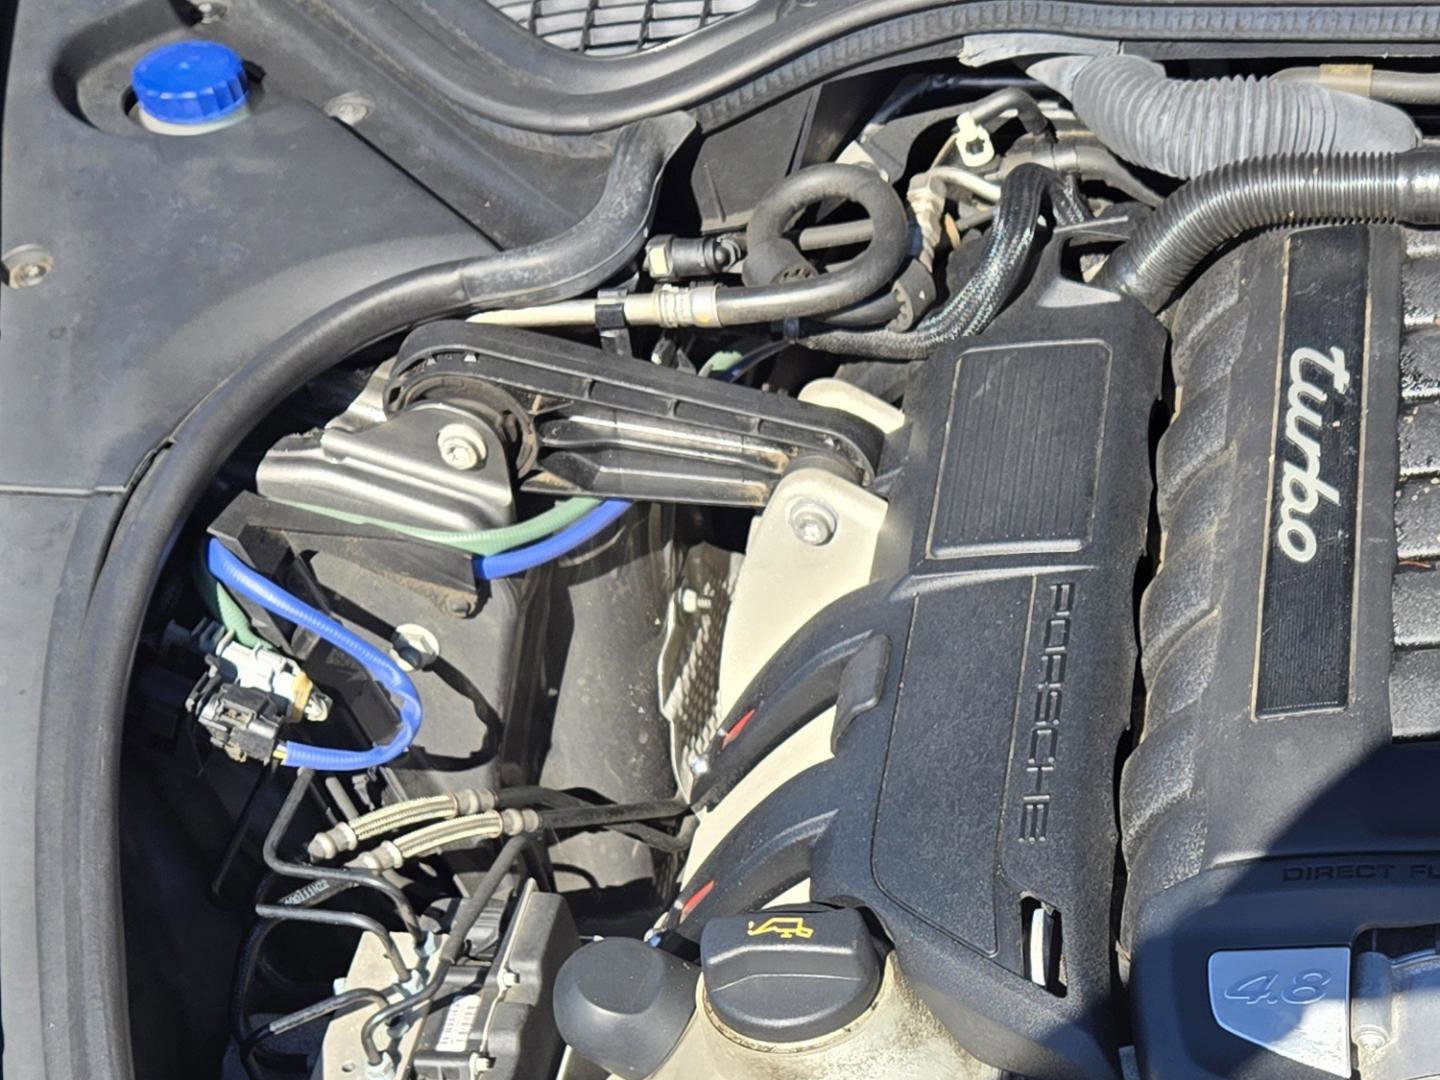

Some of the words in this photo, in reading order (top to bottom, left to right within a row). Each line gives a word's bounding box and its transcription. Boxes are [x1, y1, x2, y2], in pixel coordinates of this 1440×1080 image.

[1277, 345, 1350, 564] turbo
[1017, 582, 1076, 842] PORSCHE
[1281, 863, 1396, 884] DIRECT
[1224, 968, 1332, 1005] 4.8
